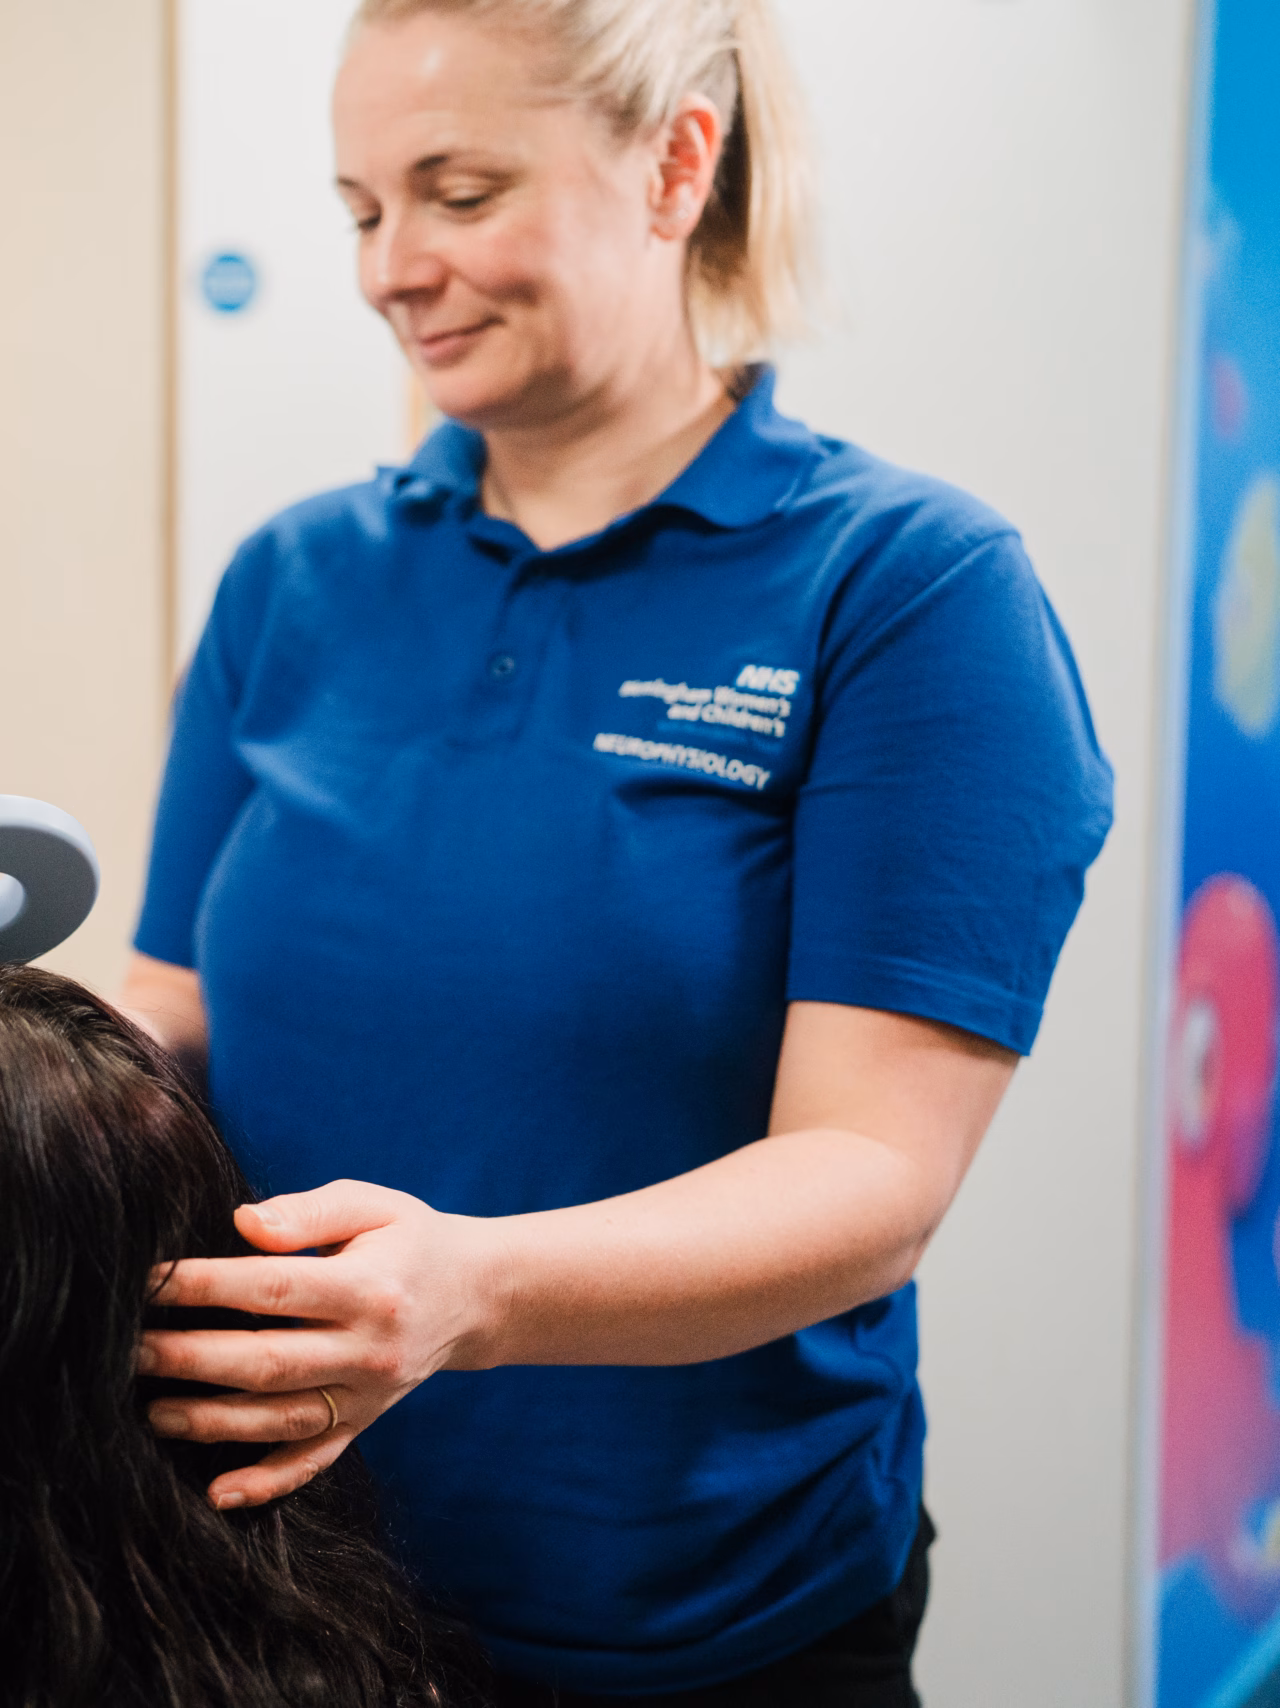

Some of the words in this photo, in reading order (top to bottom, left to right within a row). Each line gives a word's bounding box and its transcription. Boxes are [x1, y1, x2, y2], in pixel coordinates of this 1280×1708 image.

[736, 664, 800, 695] NHS
[667, 703, 702, 721] and
[593, 733, 770, 789] NEUROPHYSIOLOGY
